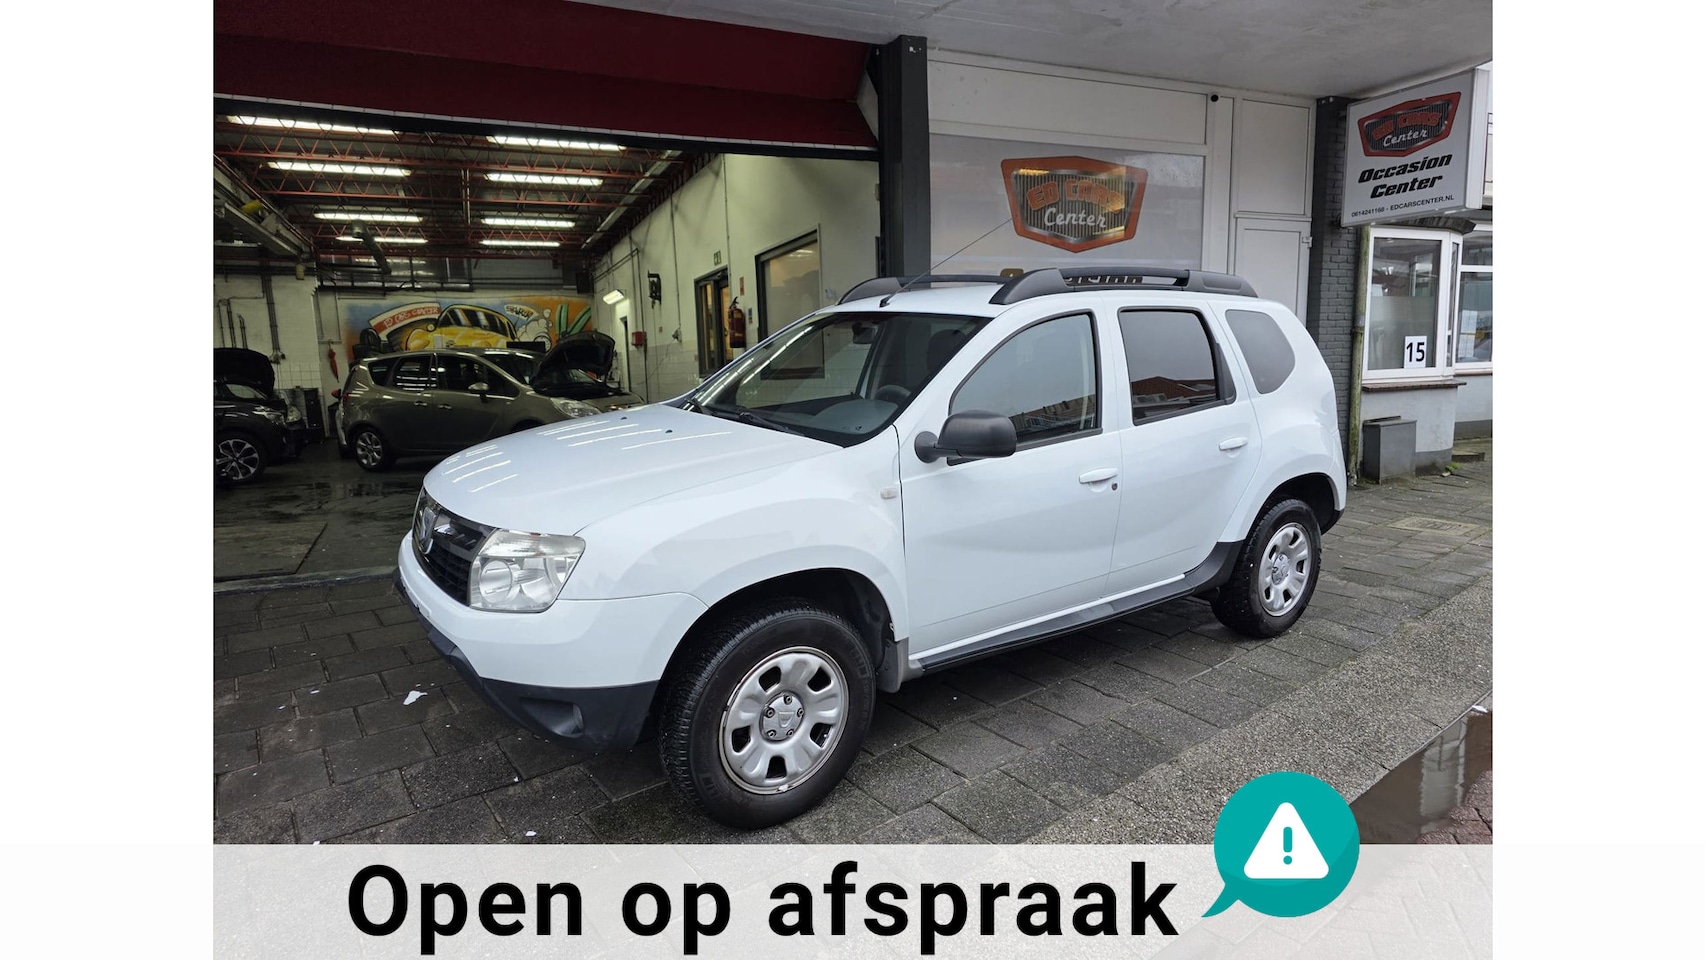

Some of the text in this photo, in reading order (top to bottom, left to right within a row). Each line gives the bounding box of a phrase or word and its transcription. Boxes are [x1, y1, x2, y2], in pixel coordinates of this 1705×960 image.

[1383, 129, 1427, 147] Center
[1358, 154, 1453, 183] Occasion
[1026, 180, 1125, 212] ED CARS
[1370, 175, 1443, 199] Center
[1390, 195, 1454, 211] EDCARSCENTER.NL
[1044, 207, 1106, 229] Center
[1406, 342, 1425, 362] 15
